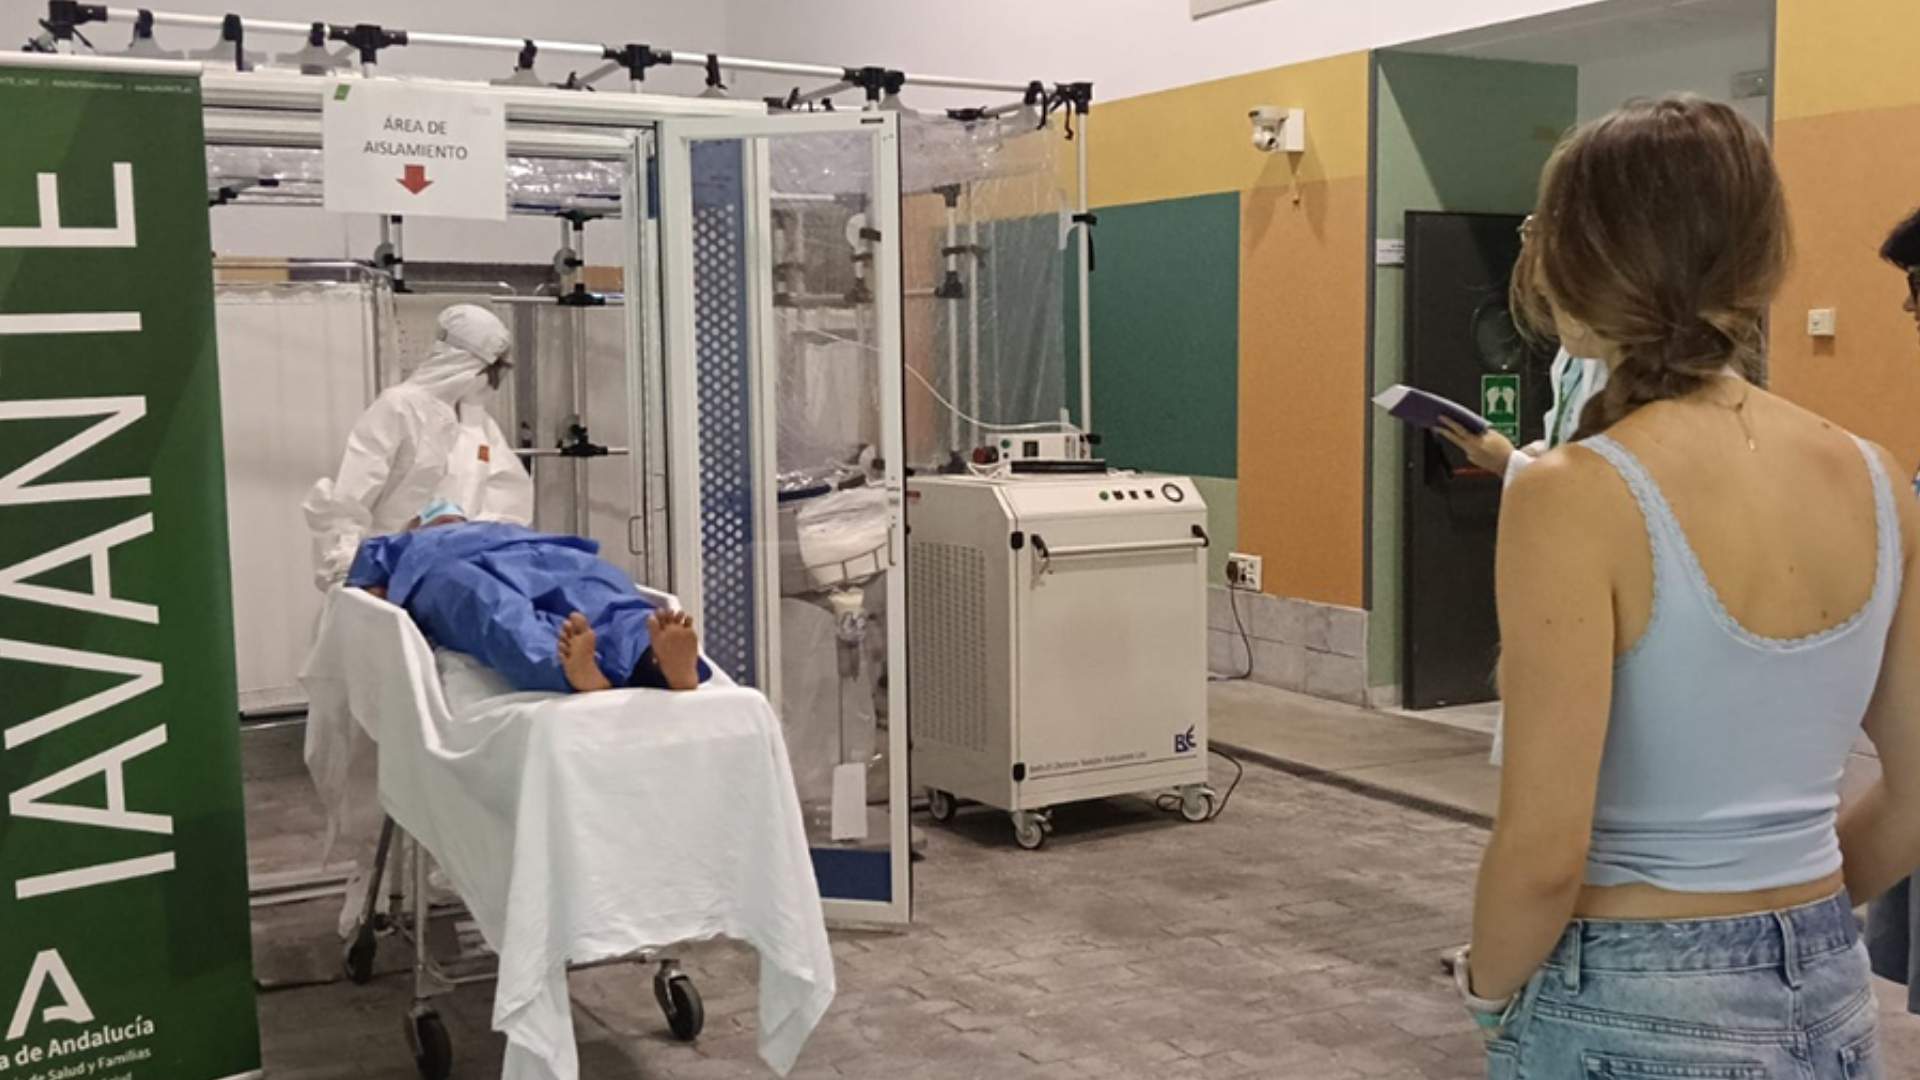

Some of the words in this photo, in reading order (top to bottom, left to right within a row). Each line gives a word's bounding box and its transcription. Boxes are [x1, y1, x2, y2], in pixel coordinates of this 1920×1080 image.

[383, 115, 424, 133] ÁREA
[428, 121, 447, 135] DE
[363, 140, 468, 160] AISLAMIENTO
[15, 1044, 43, 1065] de
[48, 1015, 155, 1058] Andalucía
[48, 1062, 86, 1080] Salud
[87, 1063, 96, 1074] y
[98, 1048, 152, 1069] Familias
